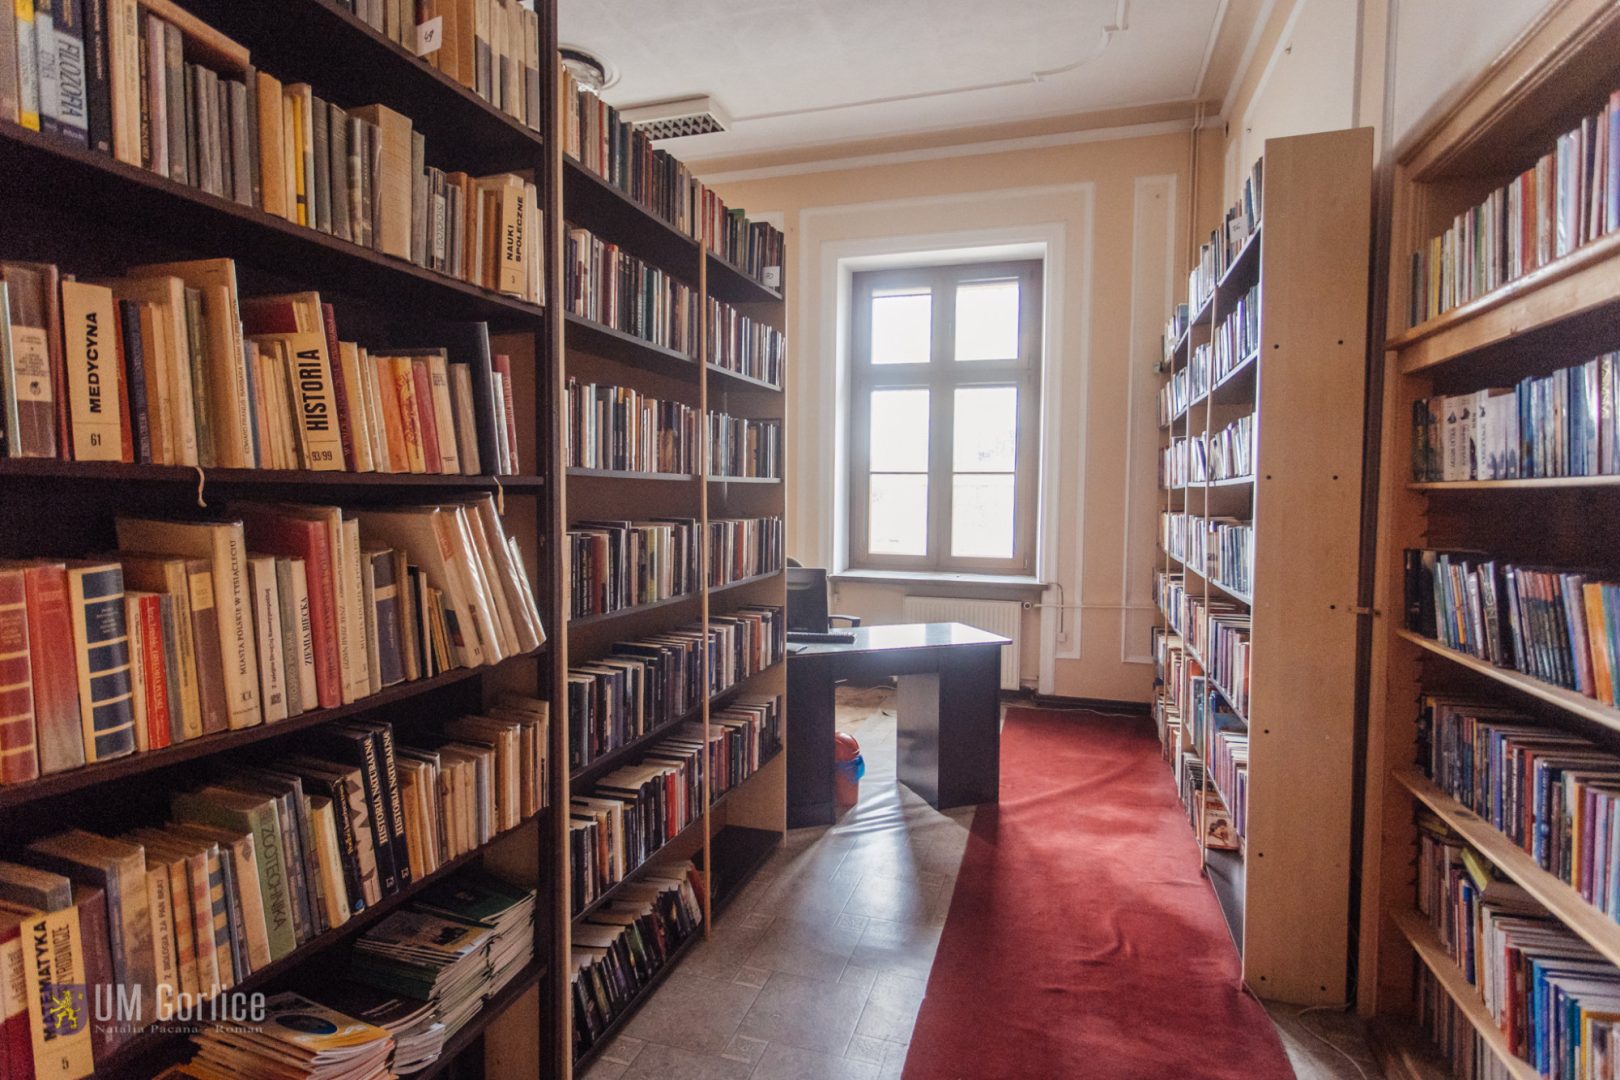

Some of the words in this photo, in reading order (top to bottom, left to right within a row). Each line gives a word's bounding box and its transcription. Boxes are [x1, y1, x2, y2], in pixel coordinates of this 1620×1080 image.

[58, 40, 82, 118] FILOZOFIA
[84, 312, 102, 414] MEDYCYNA
[296, 348, 328, 431] HISTORIA
[90, 434, 101, 446] 61
[231, 540, 241, 594] TYSIĄCLECIU
[234, 596, 240, 605] W
[300, 596, 309, 630] BIECKA
[235, 608, 244, 640] POLSKIE
[238, 642, 247, 674] MIASTA
[303, 633, 312, 665] ZIEMIA
[364, 738, 381, 795] NATURALNA
[382, 730, 398, 787] NATURALNA
[373, 795, 388, 844] HISTORIA
[390, 787, 404, 835] HISTORIA
[155, 879, 164, 899] BRAT
[261, 826, 287, 931] ZOOTECHNIKA
[157, 901, 165, 917] PAN
[159, 920, 167, 931] ZA
[34, 920, 56, 1042] MATEMATYKA
[62, 1056, 69, 1070] 5
